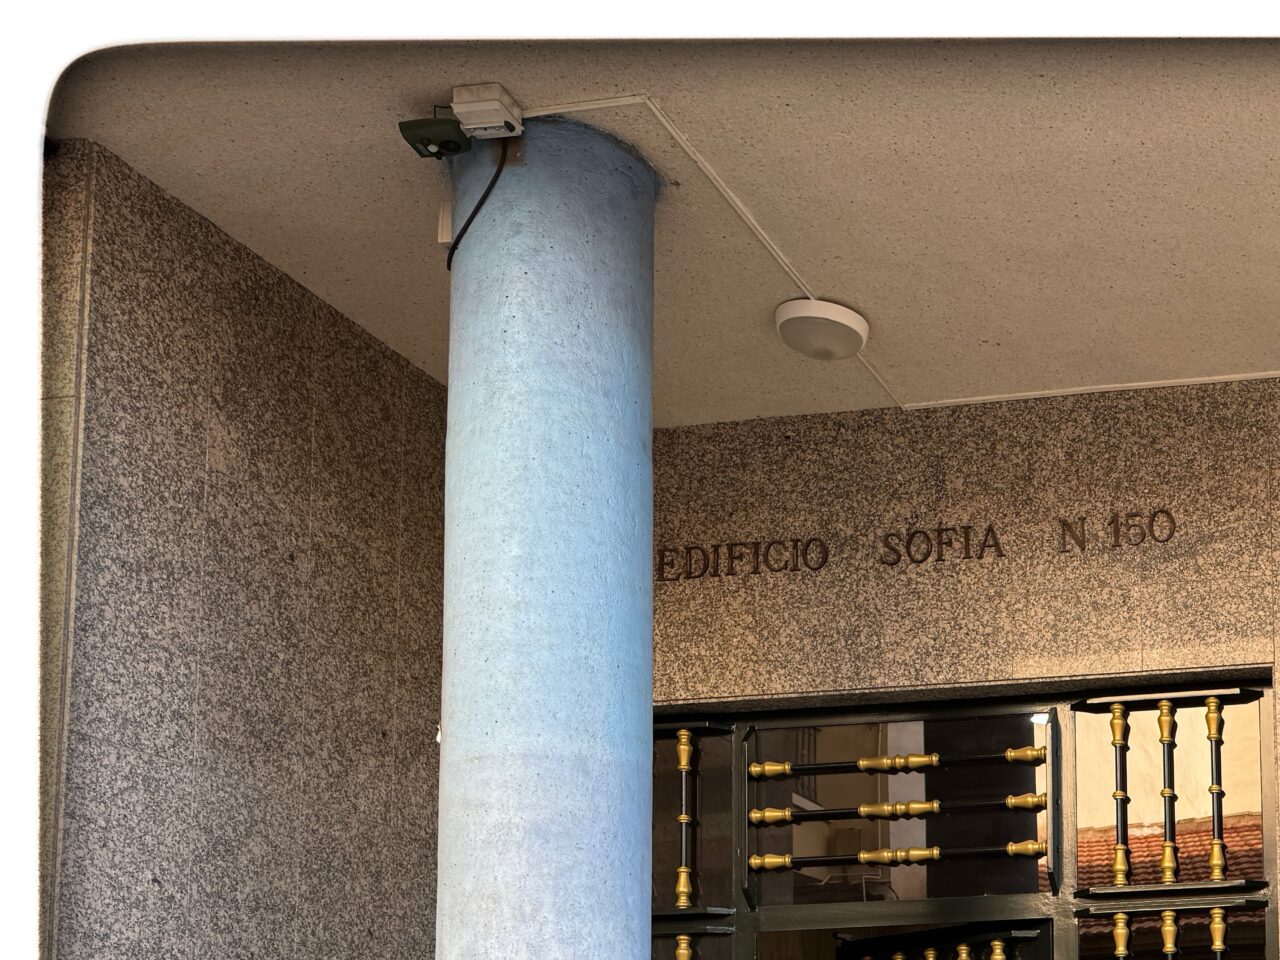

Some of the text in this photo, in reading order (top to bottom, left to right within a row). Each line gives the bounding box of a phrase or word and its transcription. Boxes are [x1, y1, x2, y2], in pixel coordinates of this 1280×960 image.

[655, 537, 829, 582] EDIFICIO
[879, 521, 1007, 566] SOFIA
[1107, 509, 1177, 548] 150
